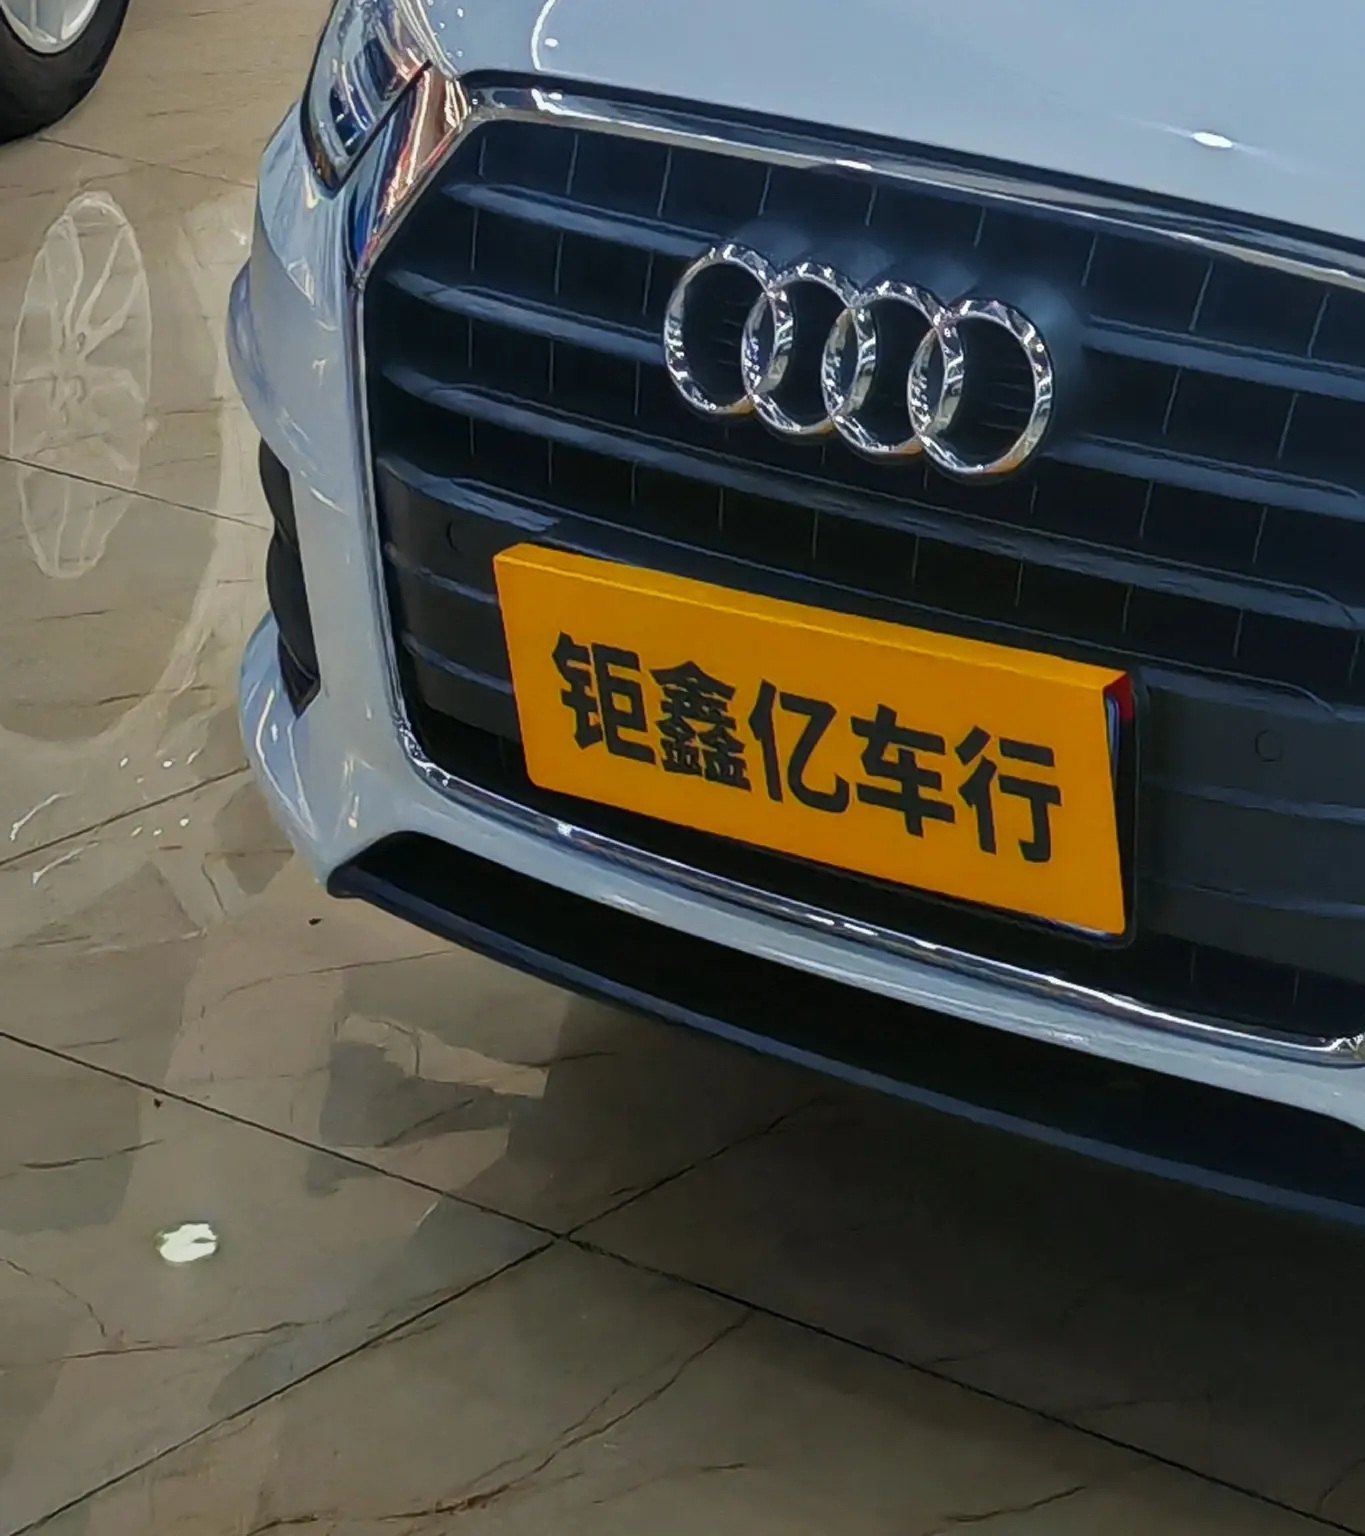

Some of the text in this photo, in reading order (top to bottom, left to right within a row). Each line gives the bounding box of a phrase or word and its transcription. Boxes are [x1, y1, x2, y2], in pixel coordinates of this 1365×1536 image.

[551, 631, 1062, 863] 钜鑫亿车行
